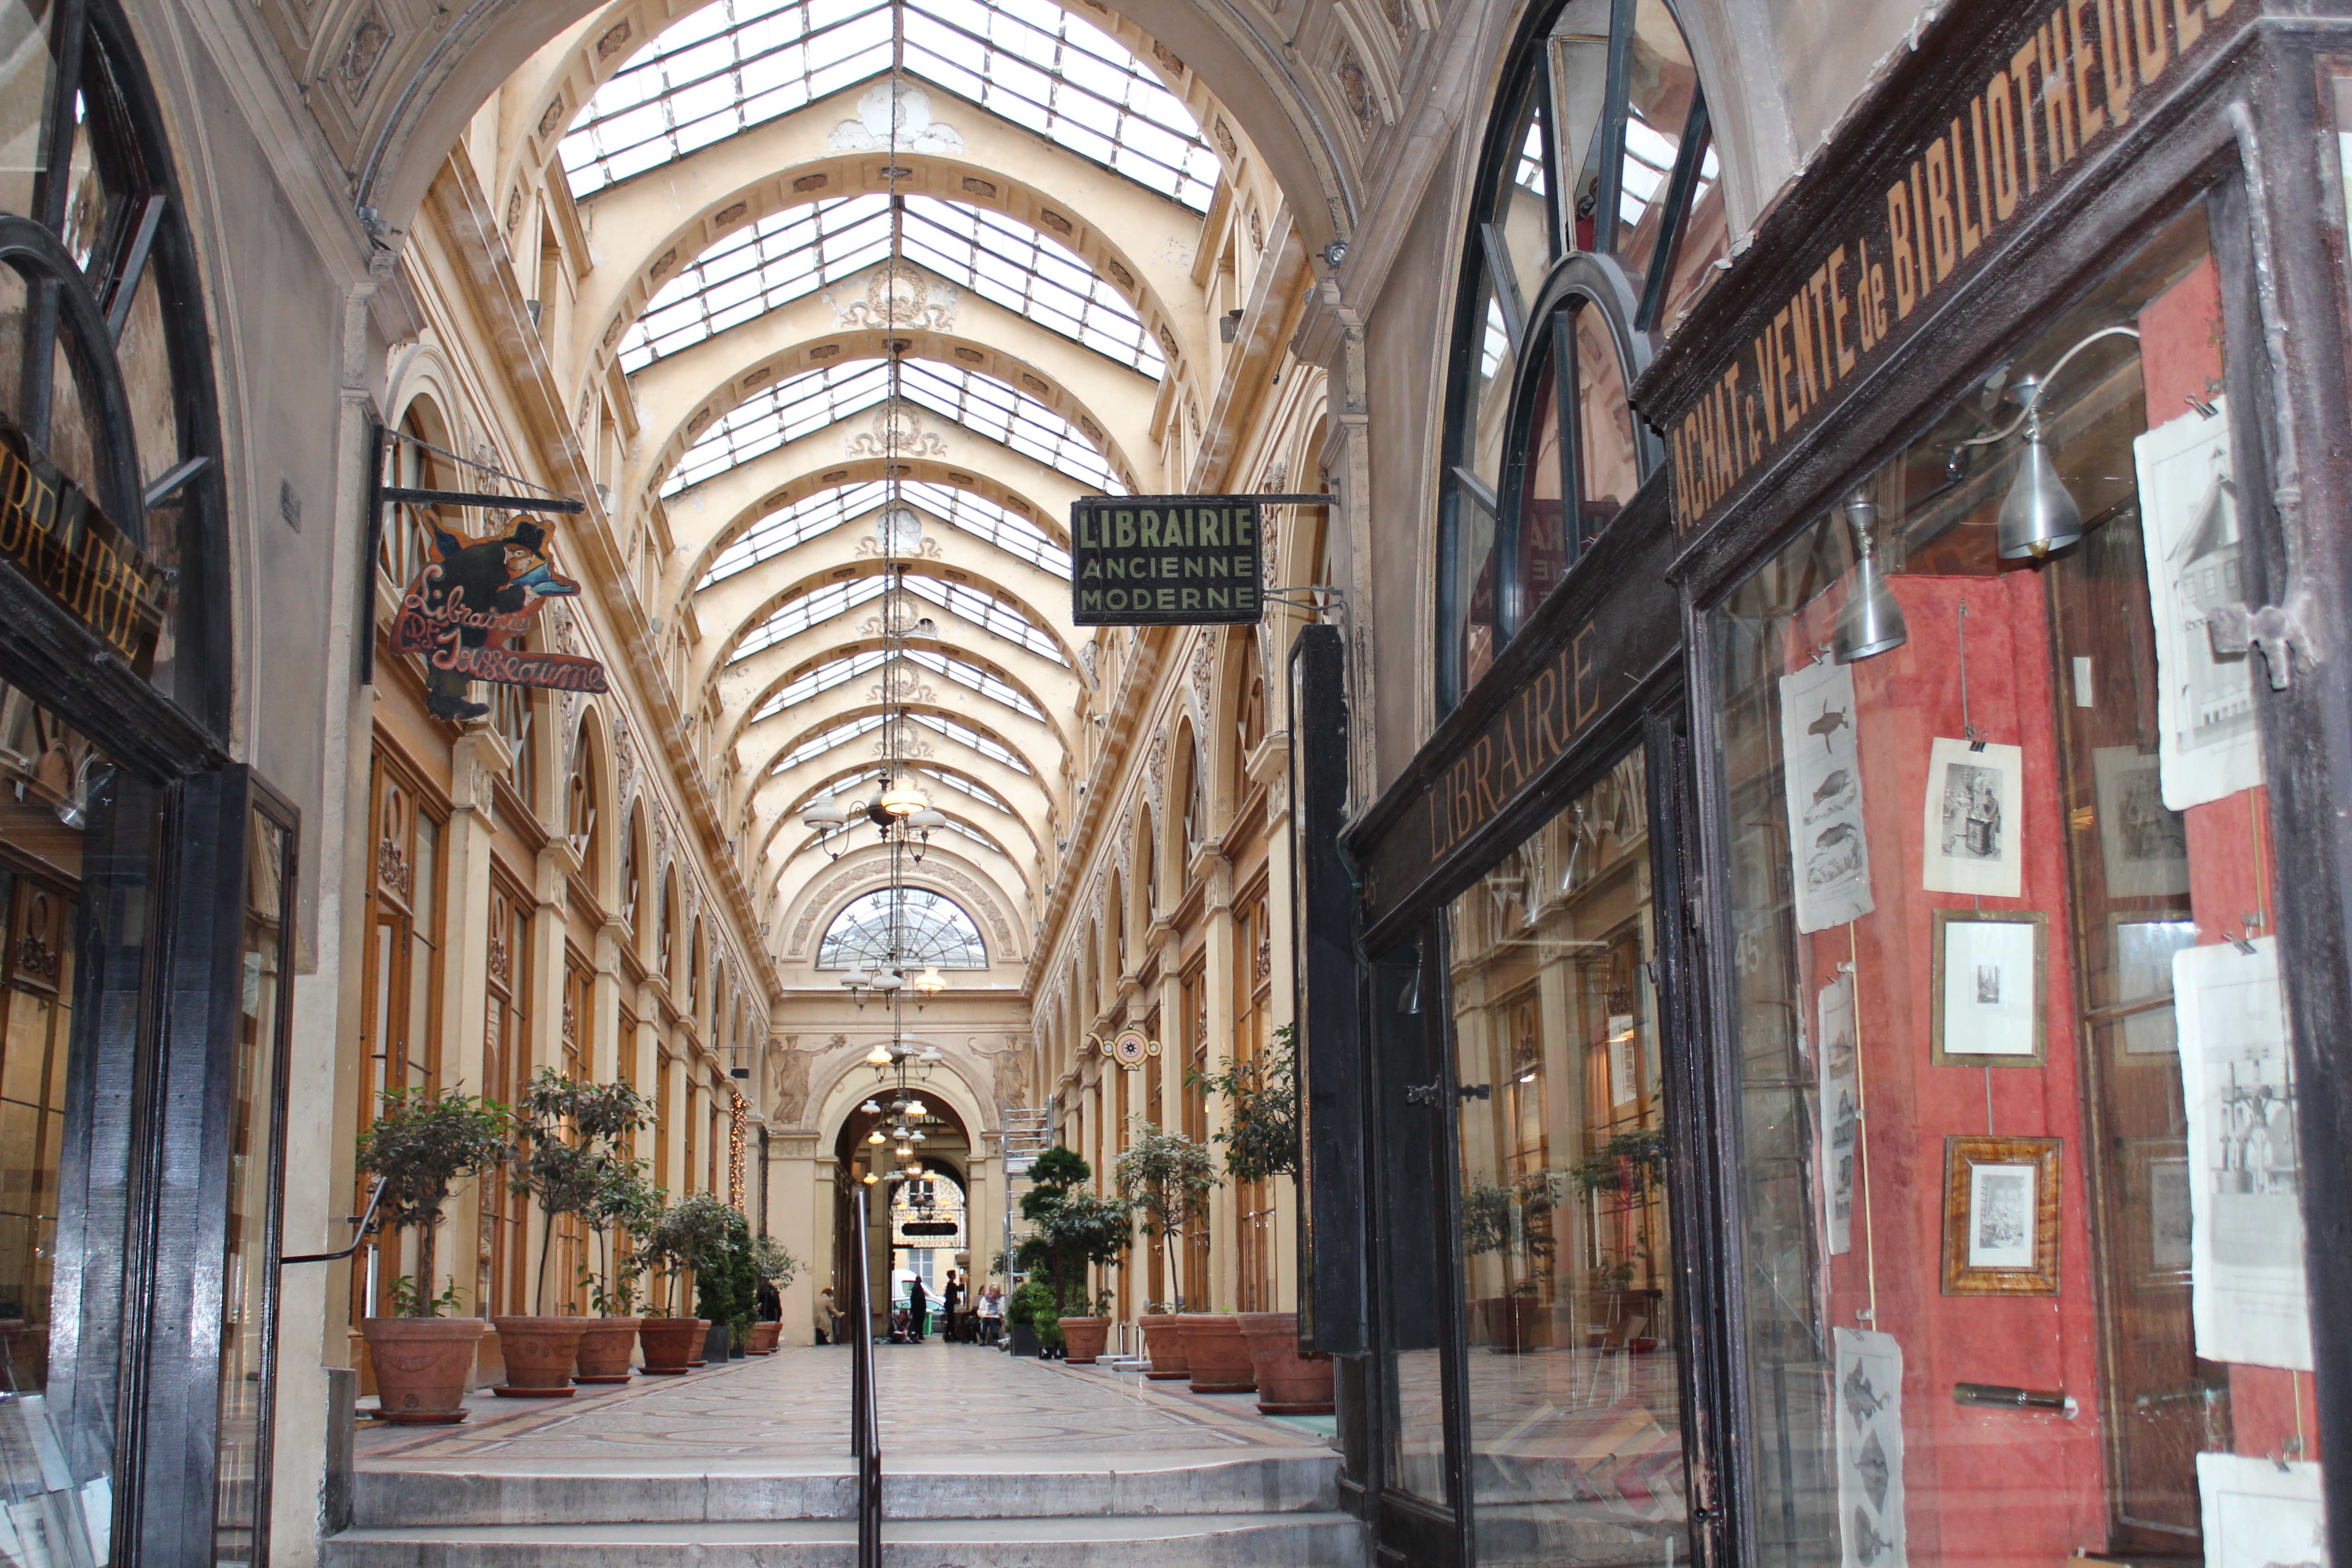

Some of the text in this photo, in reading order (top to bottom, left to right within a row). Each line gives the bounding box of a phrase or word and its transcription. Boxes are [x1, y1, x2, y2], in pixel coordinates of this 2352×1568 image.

[1674, 361, 1744, 537] ACHAT
[1745, 394, 1762, 466] &
[1755, 243, 1856, 445] VENTE
[1857, 238, 1888, 354] de
[1080, 508, 1252, 548] LIBRAIRIE
[1082, 556, 1254, 579] ANCIENNE
[405, 564, 529, 632] Librairie
[1081, 587, 1254, 611] MODERNE
[1428, 619, 1600, 863] LIBRAIRIE
[1735, 927, 1760, 978] 45
